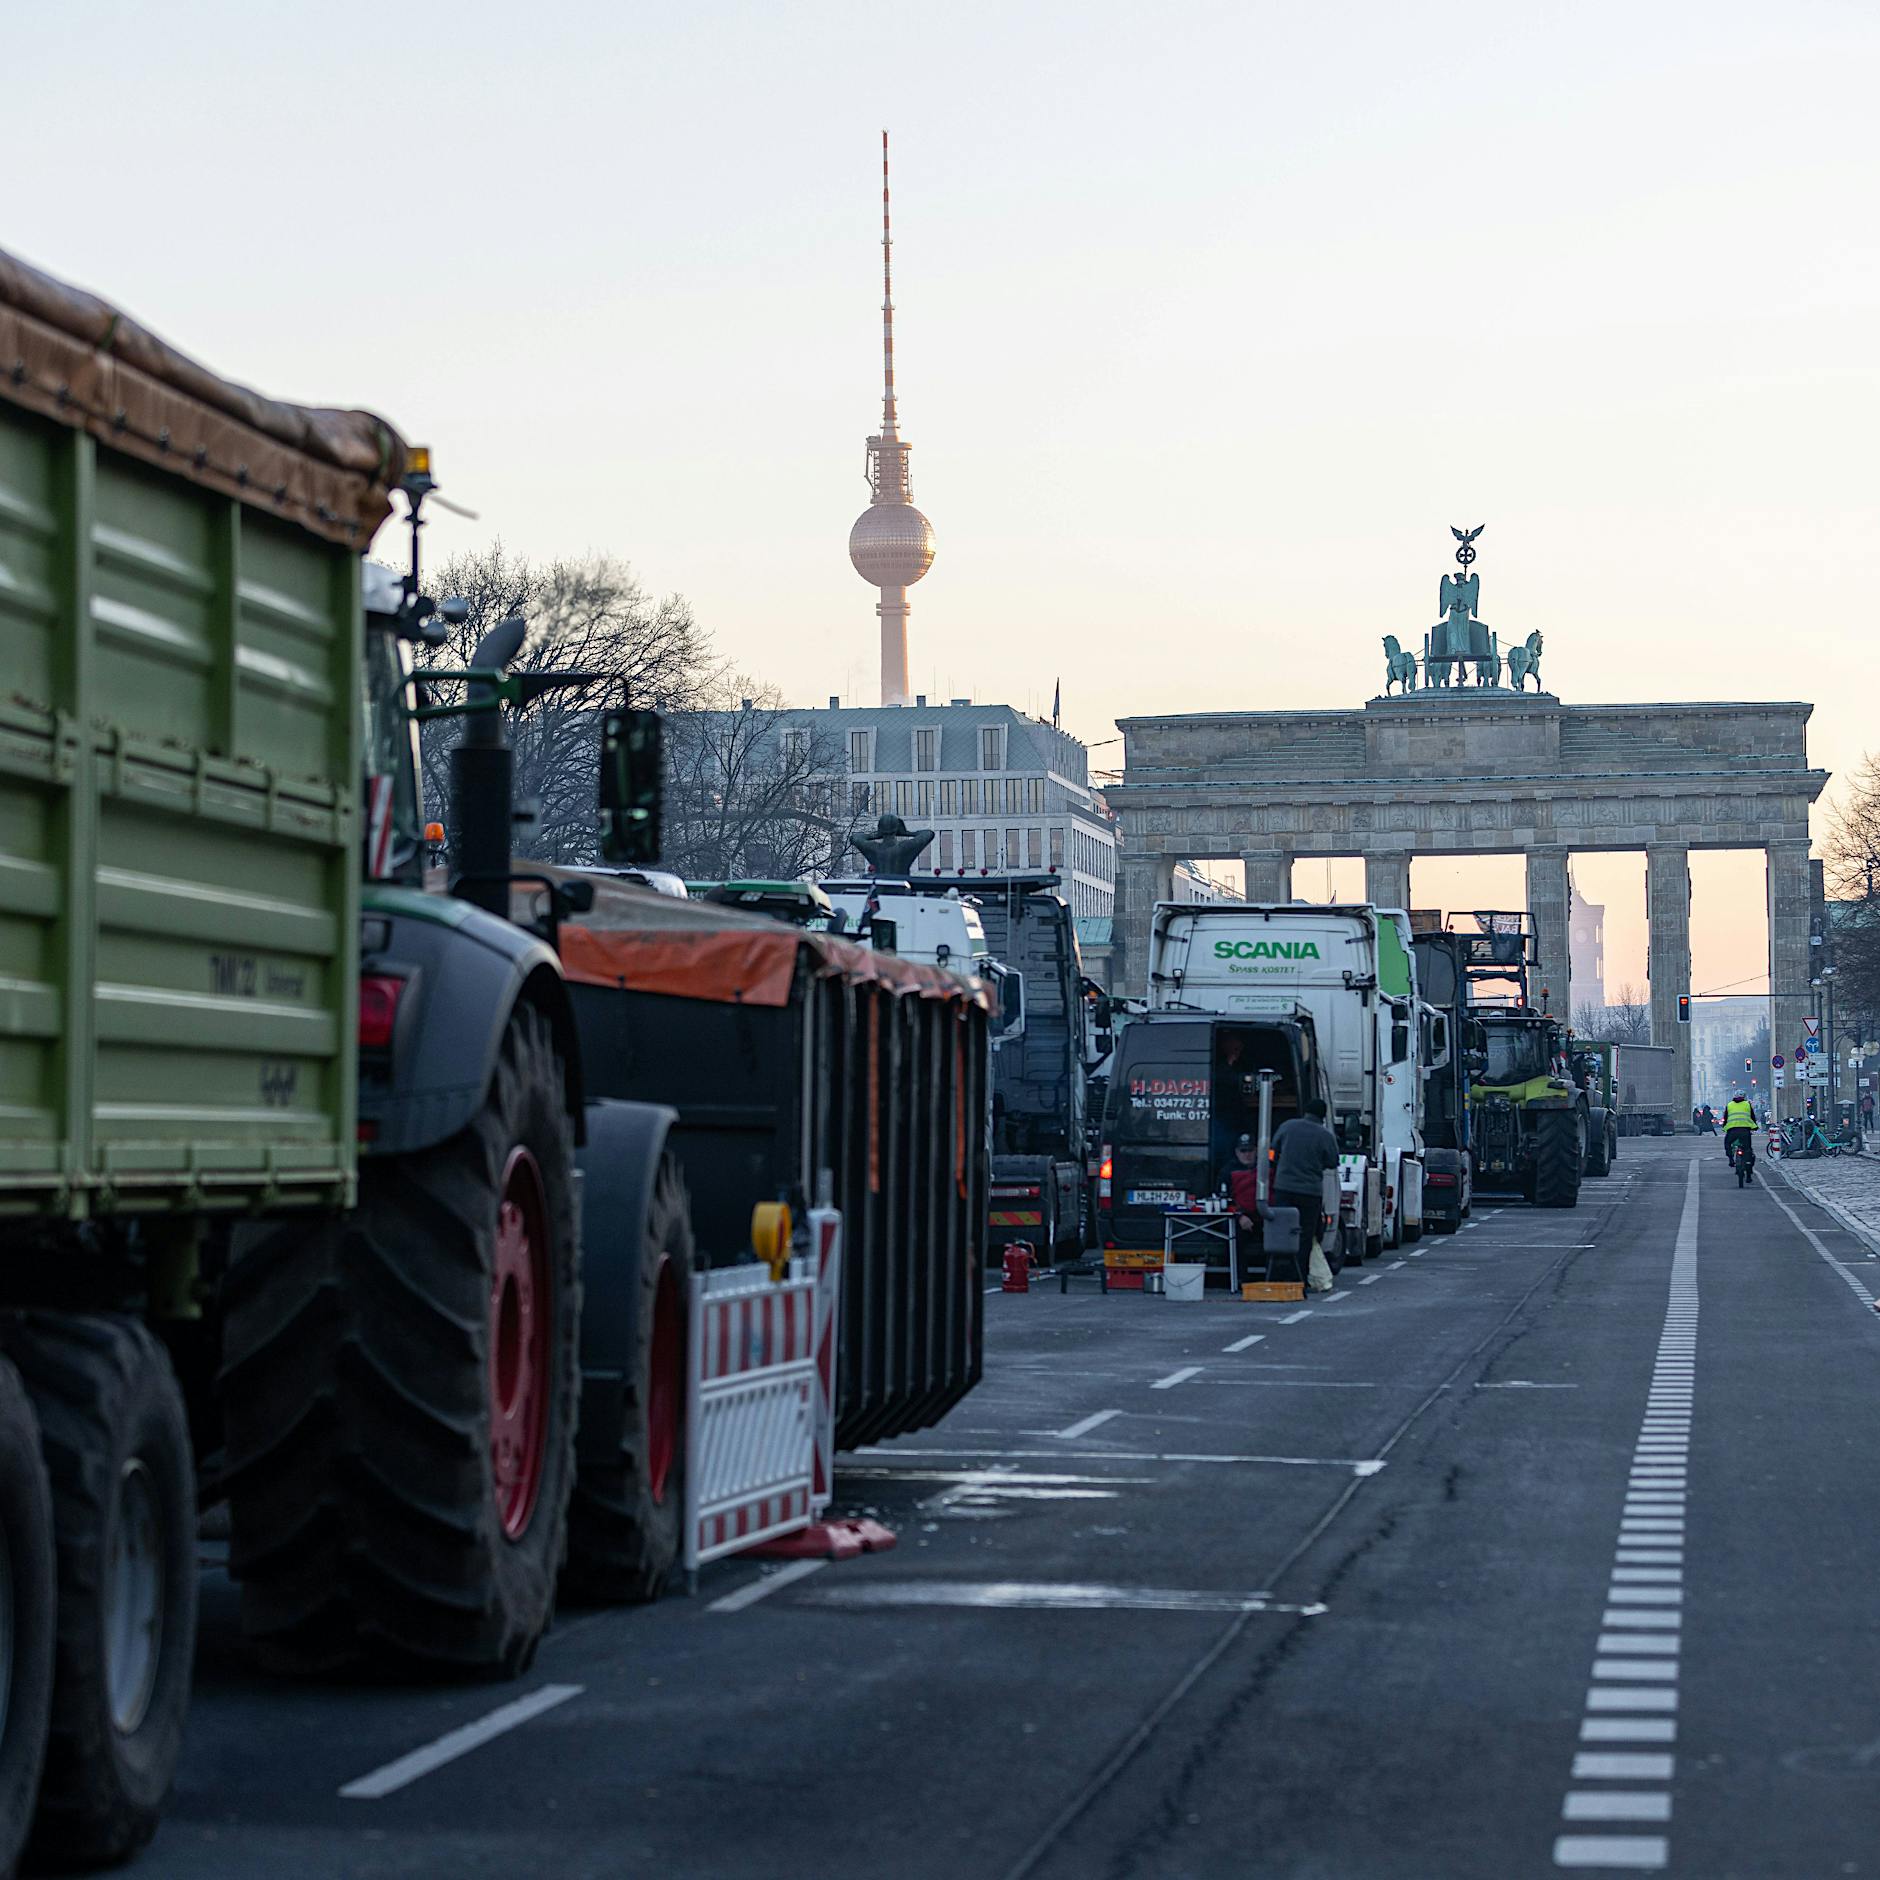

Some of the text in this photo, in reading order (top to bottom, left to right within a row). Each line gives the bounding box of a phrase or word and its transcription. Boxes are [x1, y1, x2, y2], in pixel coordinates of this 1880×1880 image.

[1214, 941, 1320, 959] SCANIA
[1130, 1079, 1209, 1095] H-DACH
[1130, 1098, 1152, 1108] Tel.:
[1156, 1110, 1185, 1120] Funk:
[1164, 1191, 1181, 1201] 269
[1424, 1209, 1446, 1217] AF
